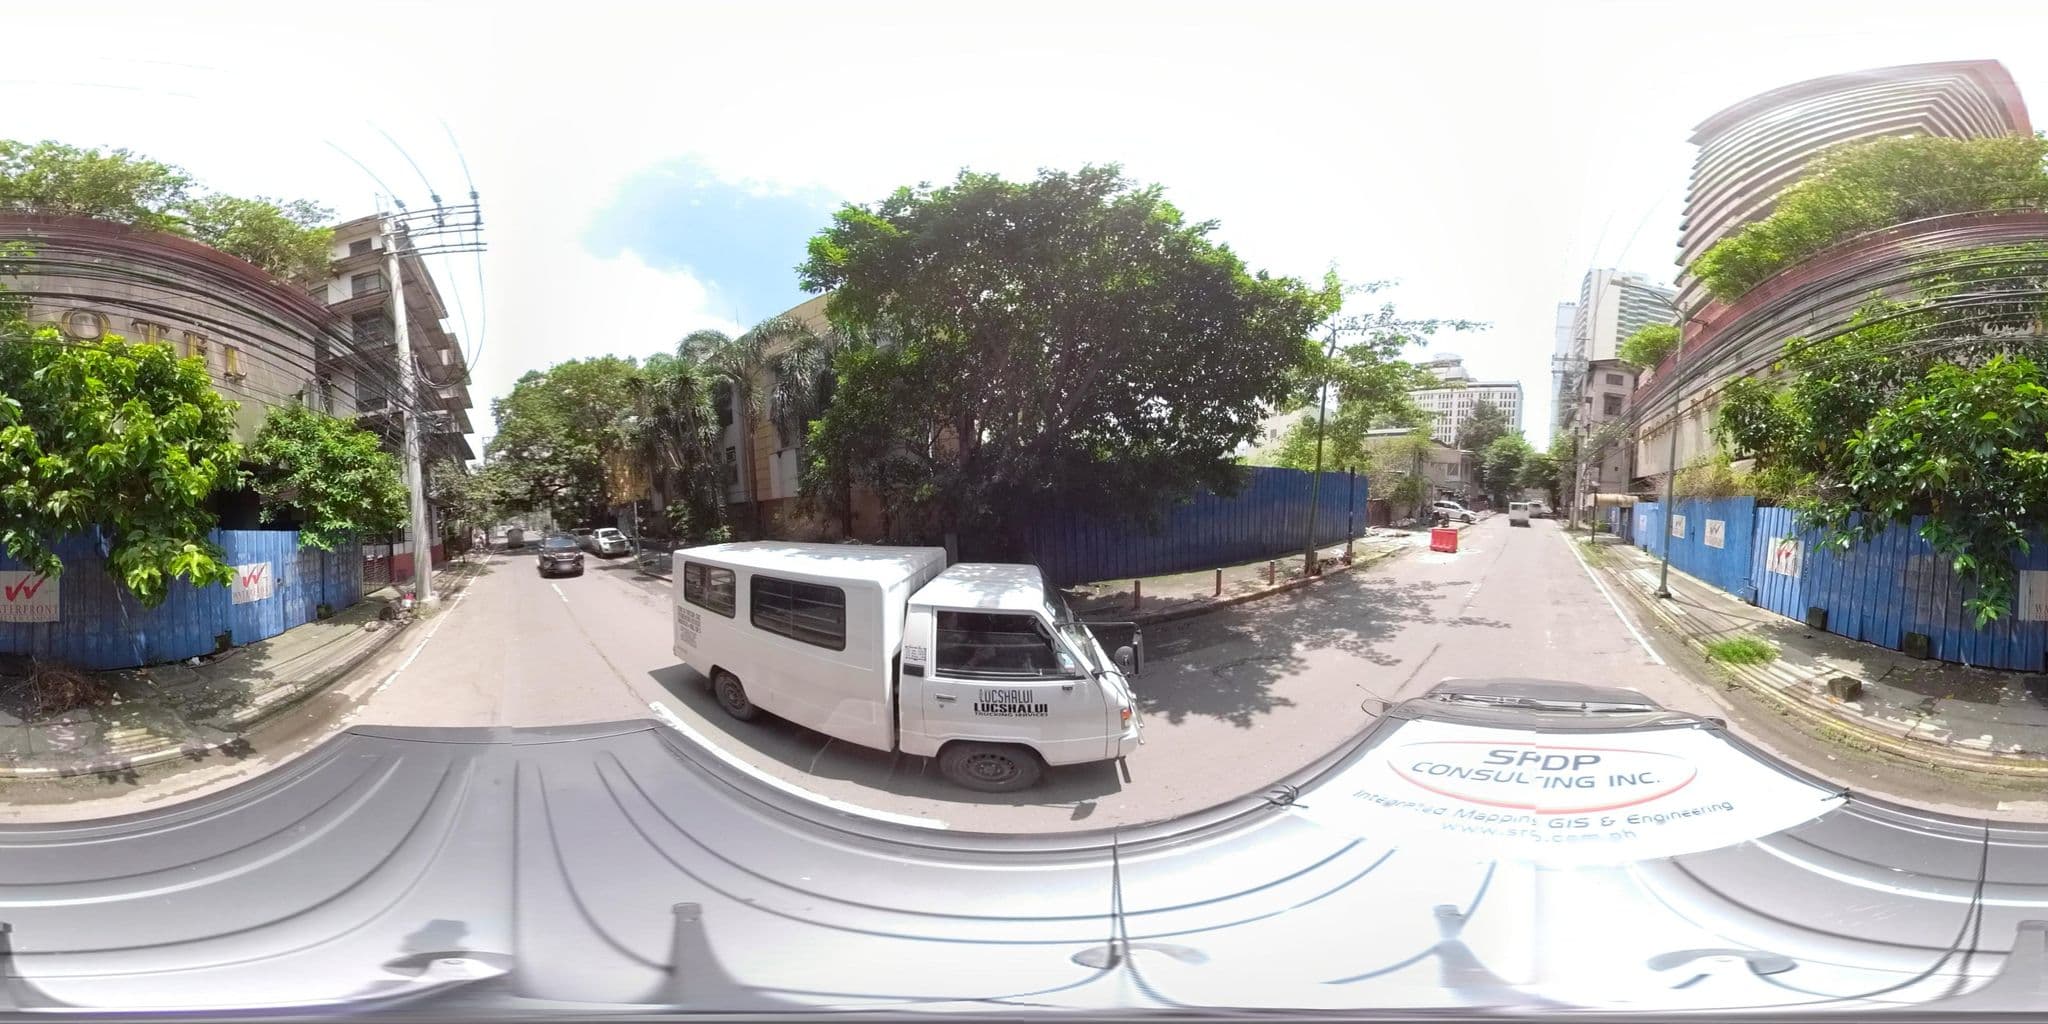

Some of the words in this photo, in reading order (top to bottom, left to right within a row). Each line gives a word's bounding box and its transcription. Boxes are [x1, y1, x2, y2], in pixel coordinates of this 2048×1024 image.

[61, 308, 248, 382] OTEL
[974, 702, 1049, 713] LUCSHALUI
[1608, 771, 1661, 788] INC.
[1547, 816, 1590, 830] GIS
[1600, 815, 1617, 828] &
[1626, 800, 1735, 825] Engineering
